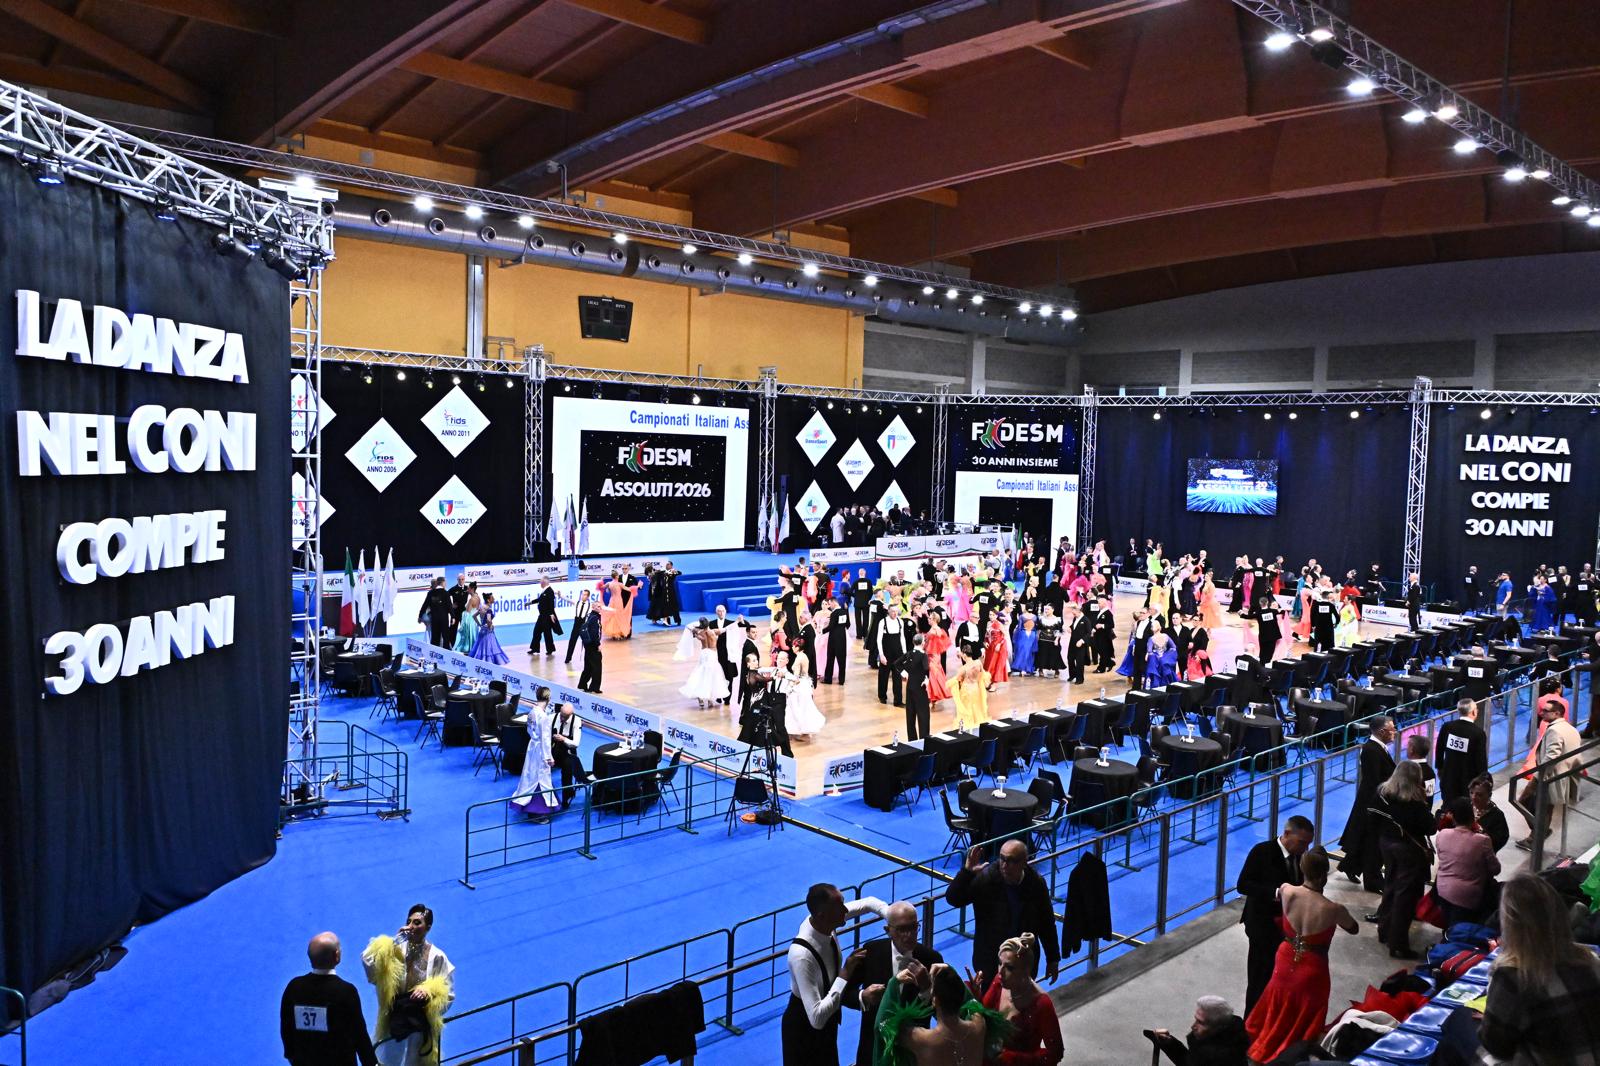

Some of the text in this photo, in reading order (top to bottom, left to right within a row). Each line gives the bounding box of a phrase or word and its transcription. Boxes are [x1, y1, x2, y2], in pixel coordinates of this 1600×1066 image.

[15, 289, 249, 384] LA DANZA
[630, 409, 690, 428] Campionati
[695, 413, 729, 428] Italiani
[16, 404, 256, 476] NEL CONI
[1465, 434, 1571, 455] LA DANZA
[972, 456, 1058, 467] 30 ANNI INSIEME
[1460, 461, 1571, 483] NEL CONI
[674, 482, 711, 497] 2026
[996, 478, 1034, 492] Campionati
[1037, 480, 1060, 492] Italiani
[1471, 491, 1550, 509] COMPIE
[1465, 519, 1553, 537] 30 ANNI
[57, 510, 226, 585] COMPIE
[493, 594, 531, 614] pionati
[44, 595, 235, 695] 30 ANNI
[1449, 738, 1464, 750] 353
[302, 1012, 317, 1026] 37
